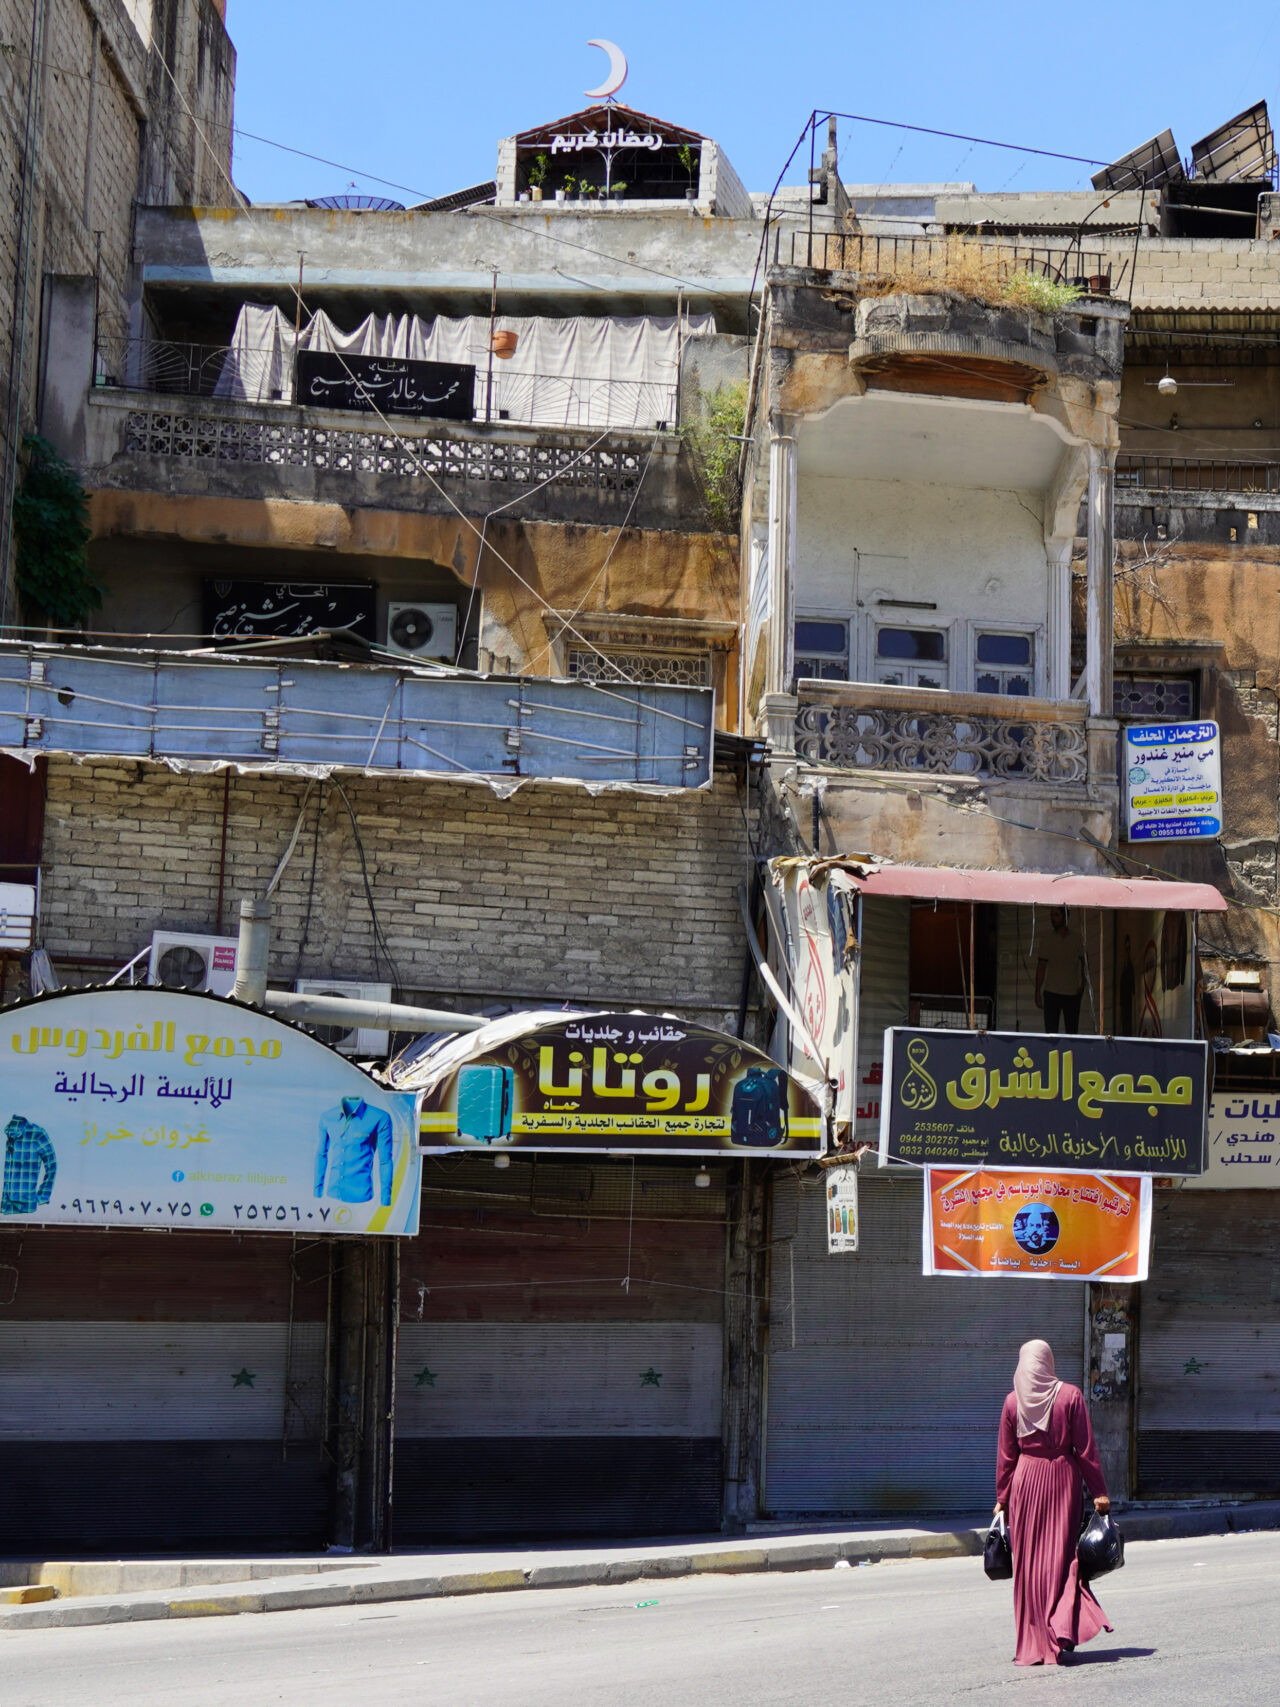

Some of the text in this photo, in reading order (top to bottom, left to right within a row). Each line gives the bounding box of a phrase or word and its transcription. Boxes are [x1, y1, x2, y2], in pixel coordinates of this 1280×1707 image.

[551, 128, 663, 154] رمضان كريم
[1132, 726, 1214, 743] الترجمان المحلف
[1133, 747, 1214, 765] مي منير غندور
[11, 1021, 283, 1066] مجمع الفردوس
[565, 1024, 687, 1044] حقائب و جلديات
[538, 1046, 711, 1112] روتانا
[946, 1047, 1193, 1119] مجمع الشرق
[54, 1071, 233, 1109] للألبسة الرجالية
[543, 1098, 580, 1111] حماه
[522, 1115, 726, 1134] لتجارة جميع الحقائب الجلدية والسفرية
[914, 1122, 975, 1133] هاتف 2535607
[78, 1121, 212, 1149] غزوان خراز
[899, 1134, 923, 1143] 0944
[925, 1135, 959, 1145] 302757
[1000, 1130, 1059, 1158] الرجالية
[1226, 1131, 1275, 1144] هندي
[899, 1145, 922, 1155] 0932
[924, 1147, 959, 1157] 040240
[1124, 1143, 1132, 1160] و
[1220, 1152, 1271, 1165] سحلب
[971, 1187, 993, 1206] مجمع
[996, 1181, 1006, 1202] في
[1045, 1179, 1070, 1197] محلات
[939, 1188, 969, 1213] الشرق
[233, 1203, 331, 1222] ٢٥٣٥٦٠٧
